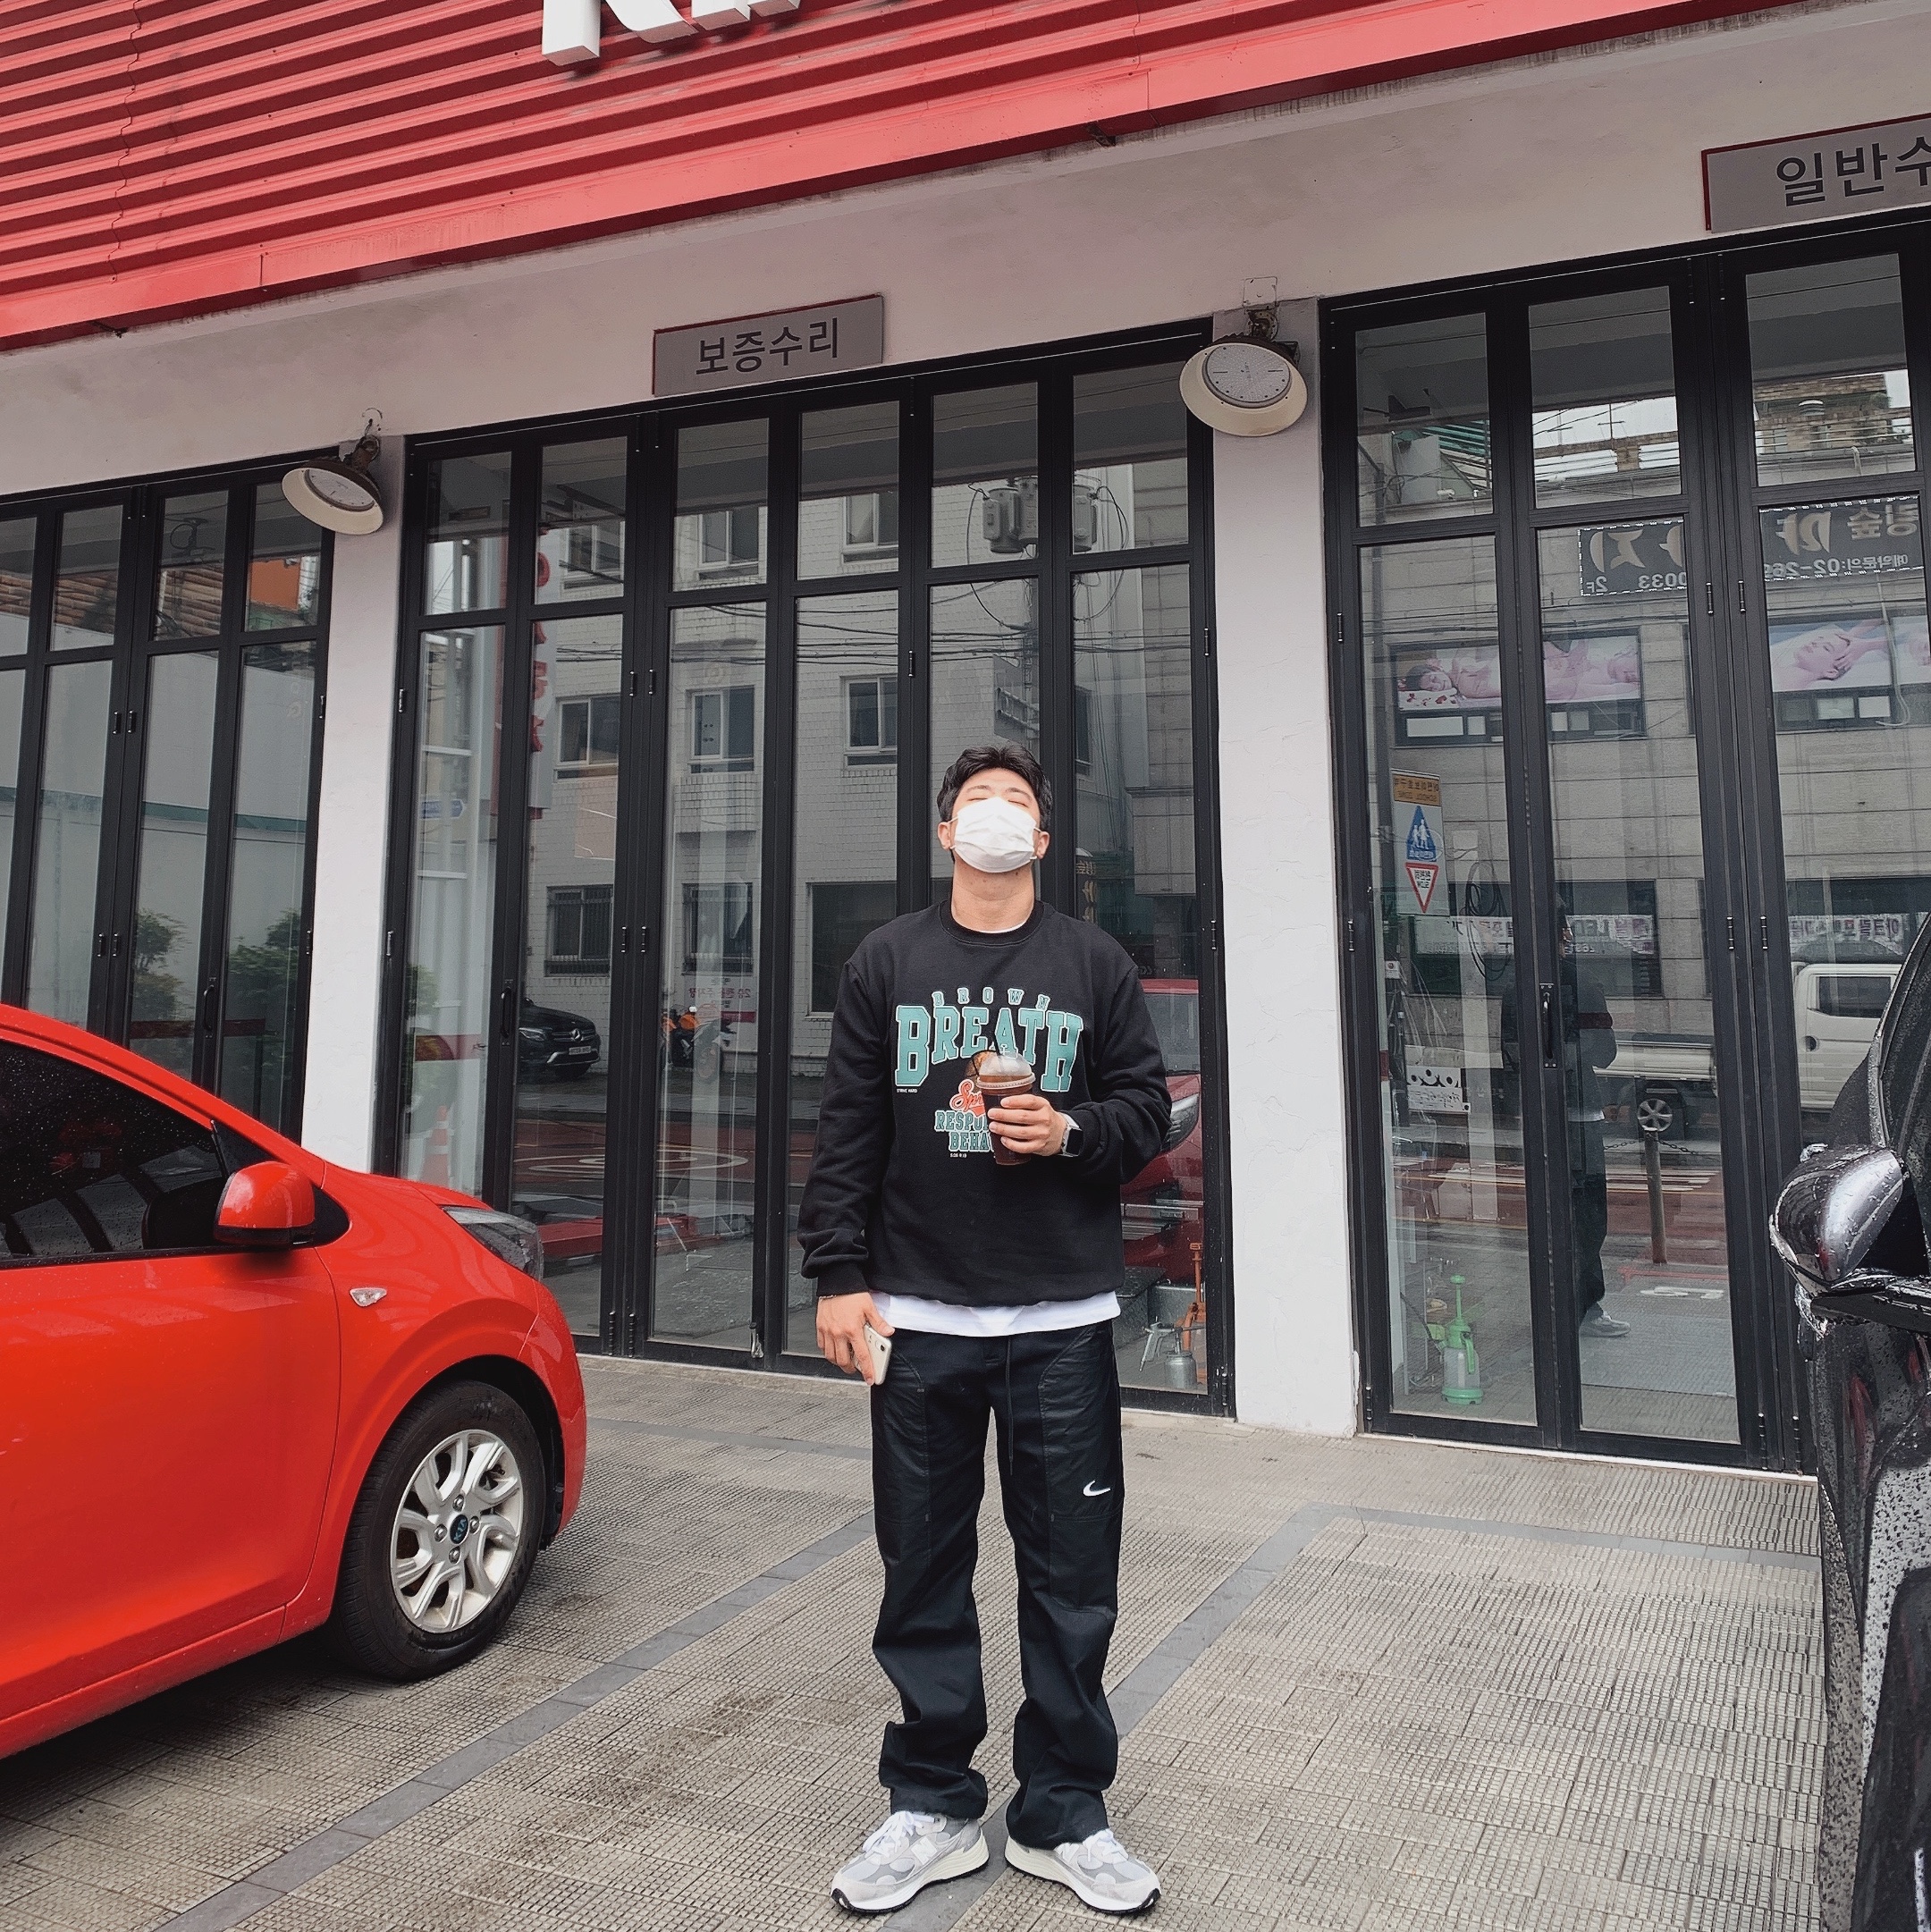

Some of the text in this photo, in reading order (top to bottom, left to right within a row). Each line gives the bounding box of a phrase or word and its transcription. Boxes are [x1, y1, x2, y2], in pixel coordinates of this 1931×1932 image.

[1776, 136, 1931, 207] 일반수
[696, 316, 838, 375] 보증수리
[932, 986, 1050, 1010] BROWN
[895, 1005, 1084, 1093] BREATH
[949, 1131, 994, 1152] BEHA
